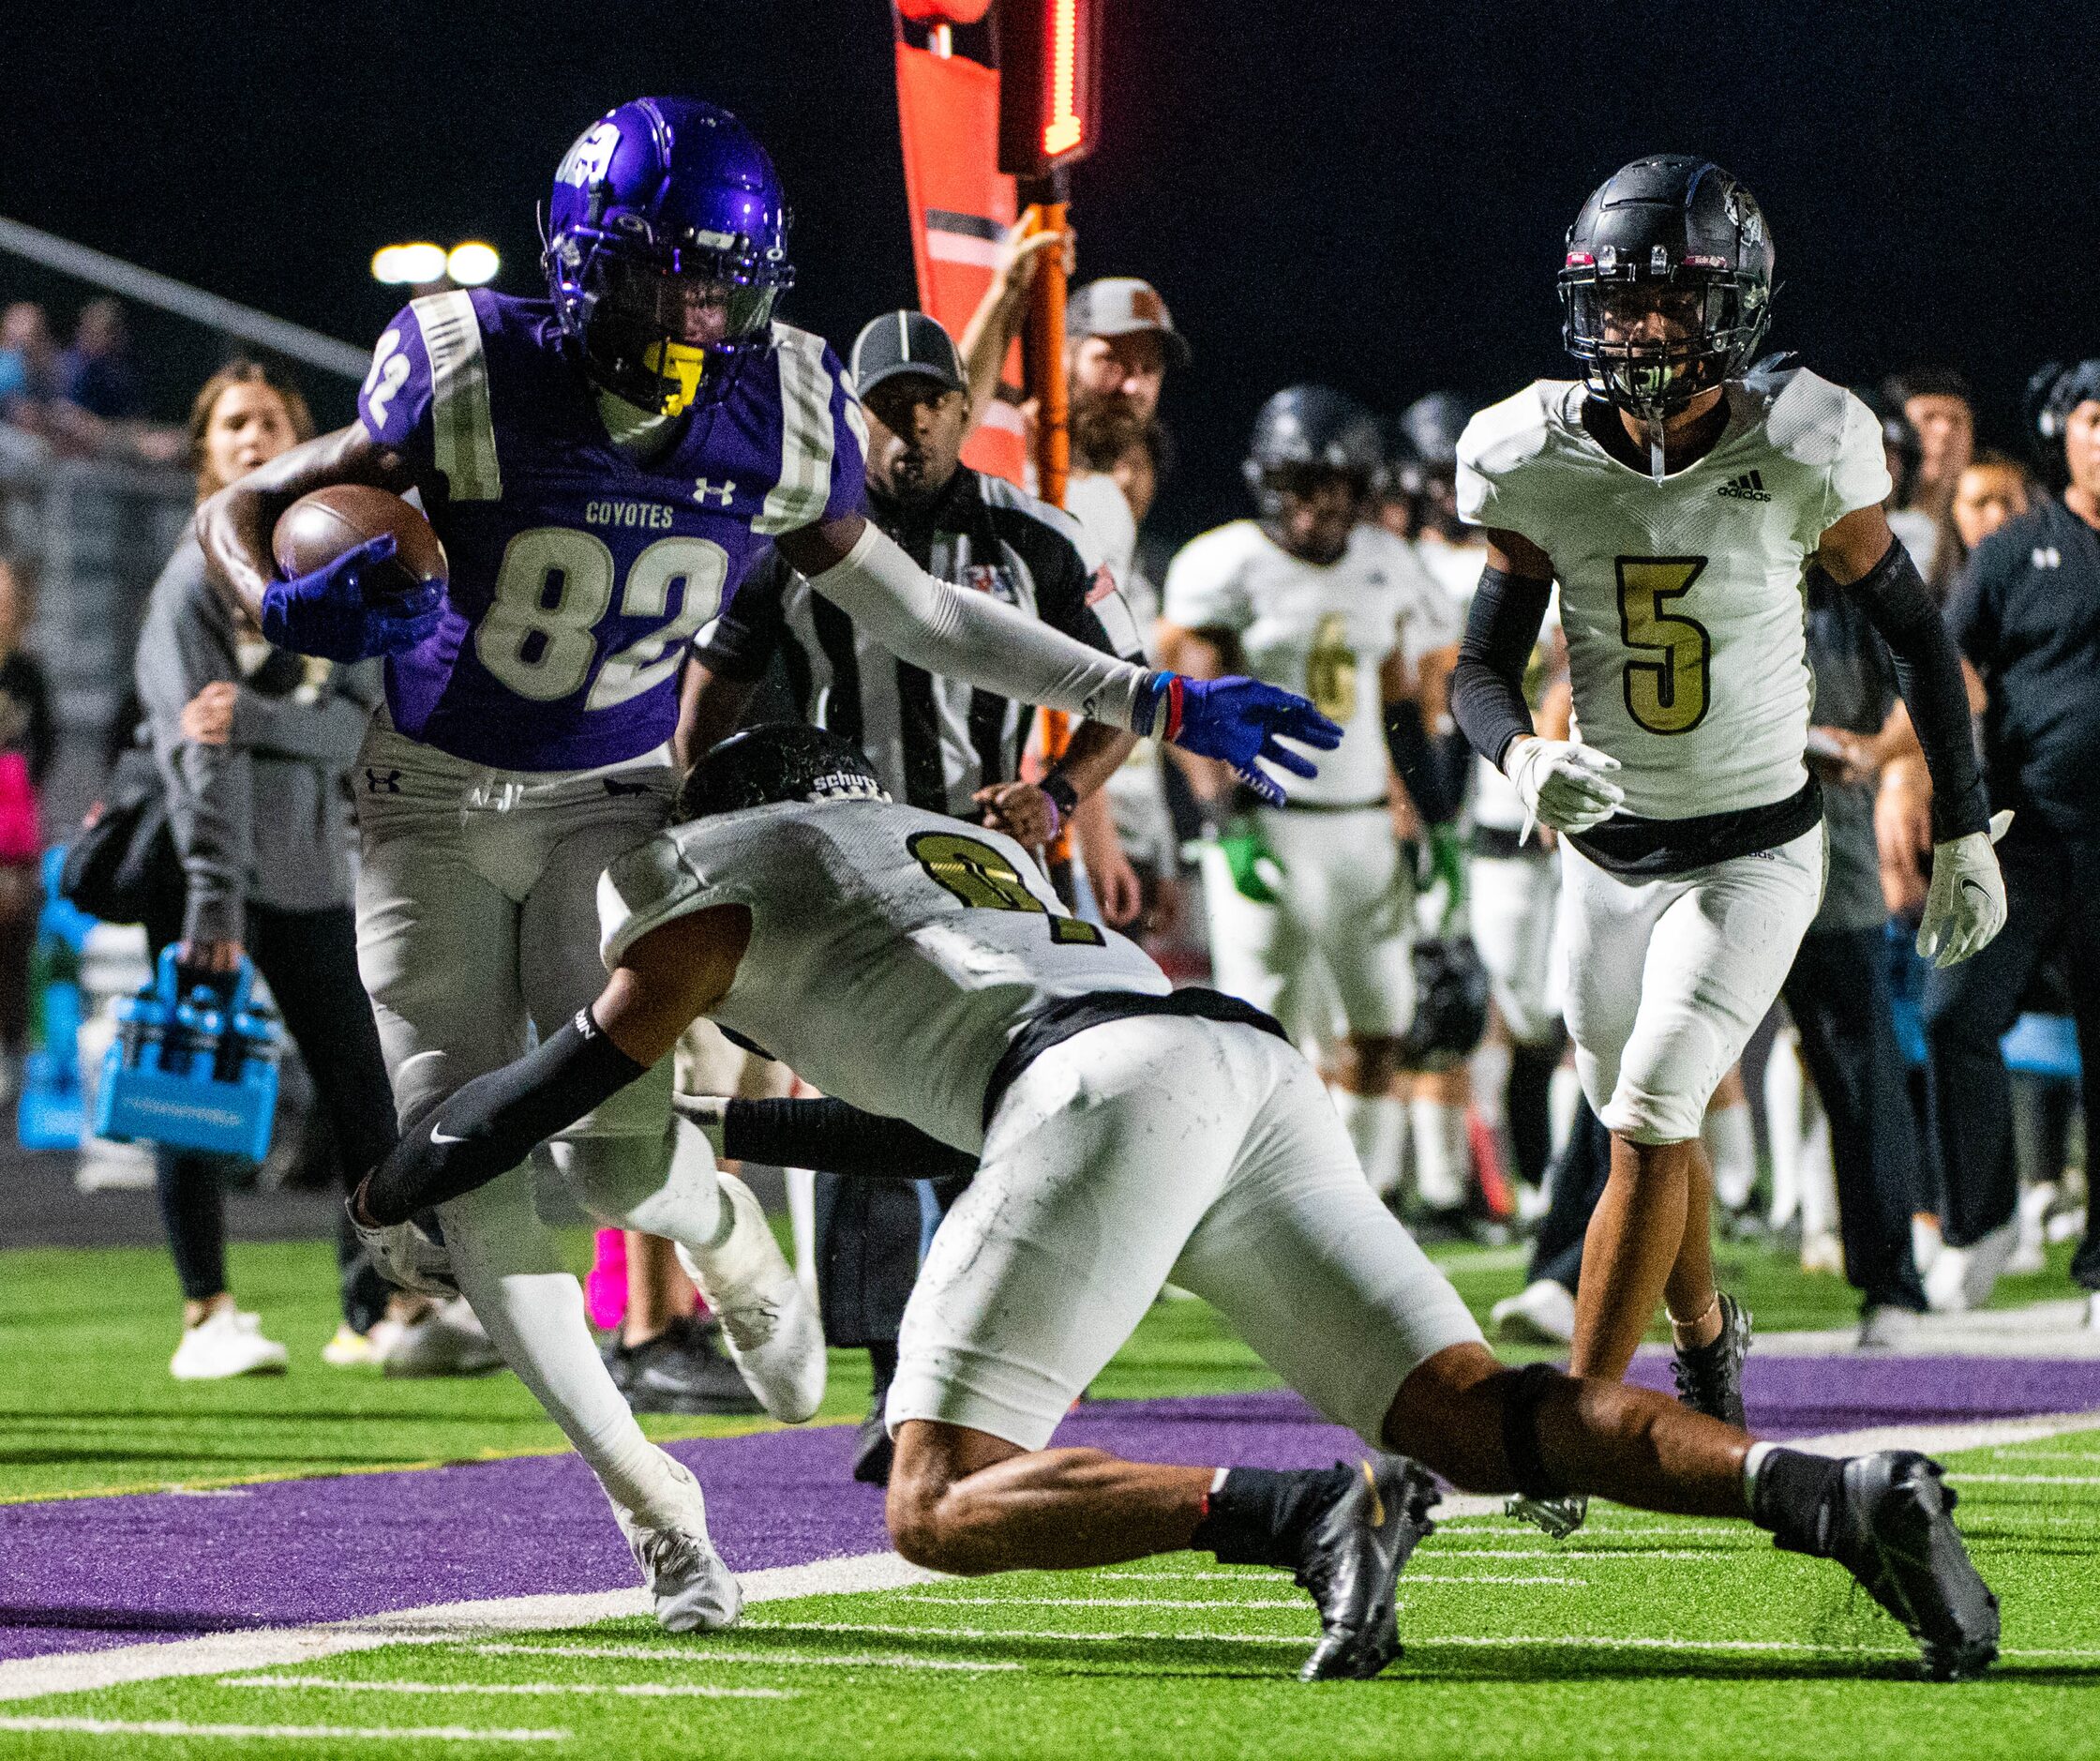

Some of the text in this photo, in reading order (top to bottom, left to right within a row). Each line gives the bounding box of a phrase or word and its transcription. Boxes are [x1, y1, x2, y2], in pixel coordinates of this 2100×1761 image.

[585, 501, 674, 529] COYOTES
[1718, 487, 1772, 503] adidas
[474, 526, 729, 712] 82
[1614, 555, 1711, 736] 5
